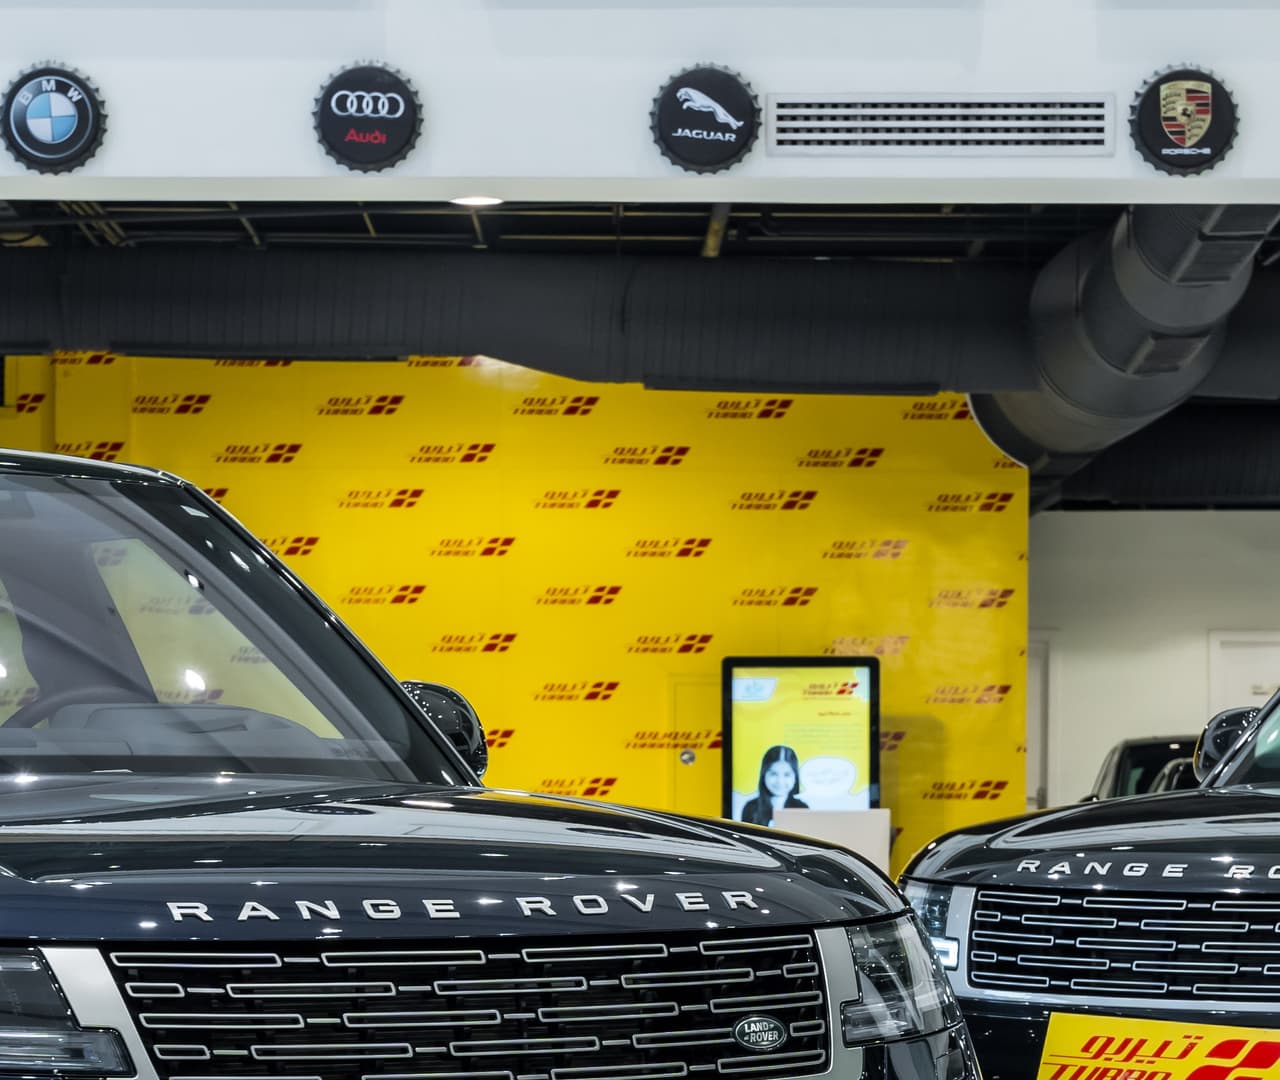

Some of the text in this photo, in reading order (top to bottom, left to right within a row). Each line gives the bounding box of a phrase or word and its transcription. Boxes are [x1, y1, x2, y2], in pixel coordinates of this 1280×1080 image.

[20, 79, 82, 106] BMW
[344, 128, 387, 144] Audi
[671, 127, 737, 143] JAGUAR
[1017, 860, 1188, 878] RANGE
[166, 890, 760, 921] RANGE ROVER
[744, 1021, 769, 1033] LAND
[750, 1030, 779, 1042] ROVER
[1049, 1035, 1204, 1065] تيربو
